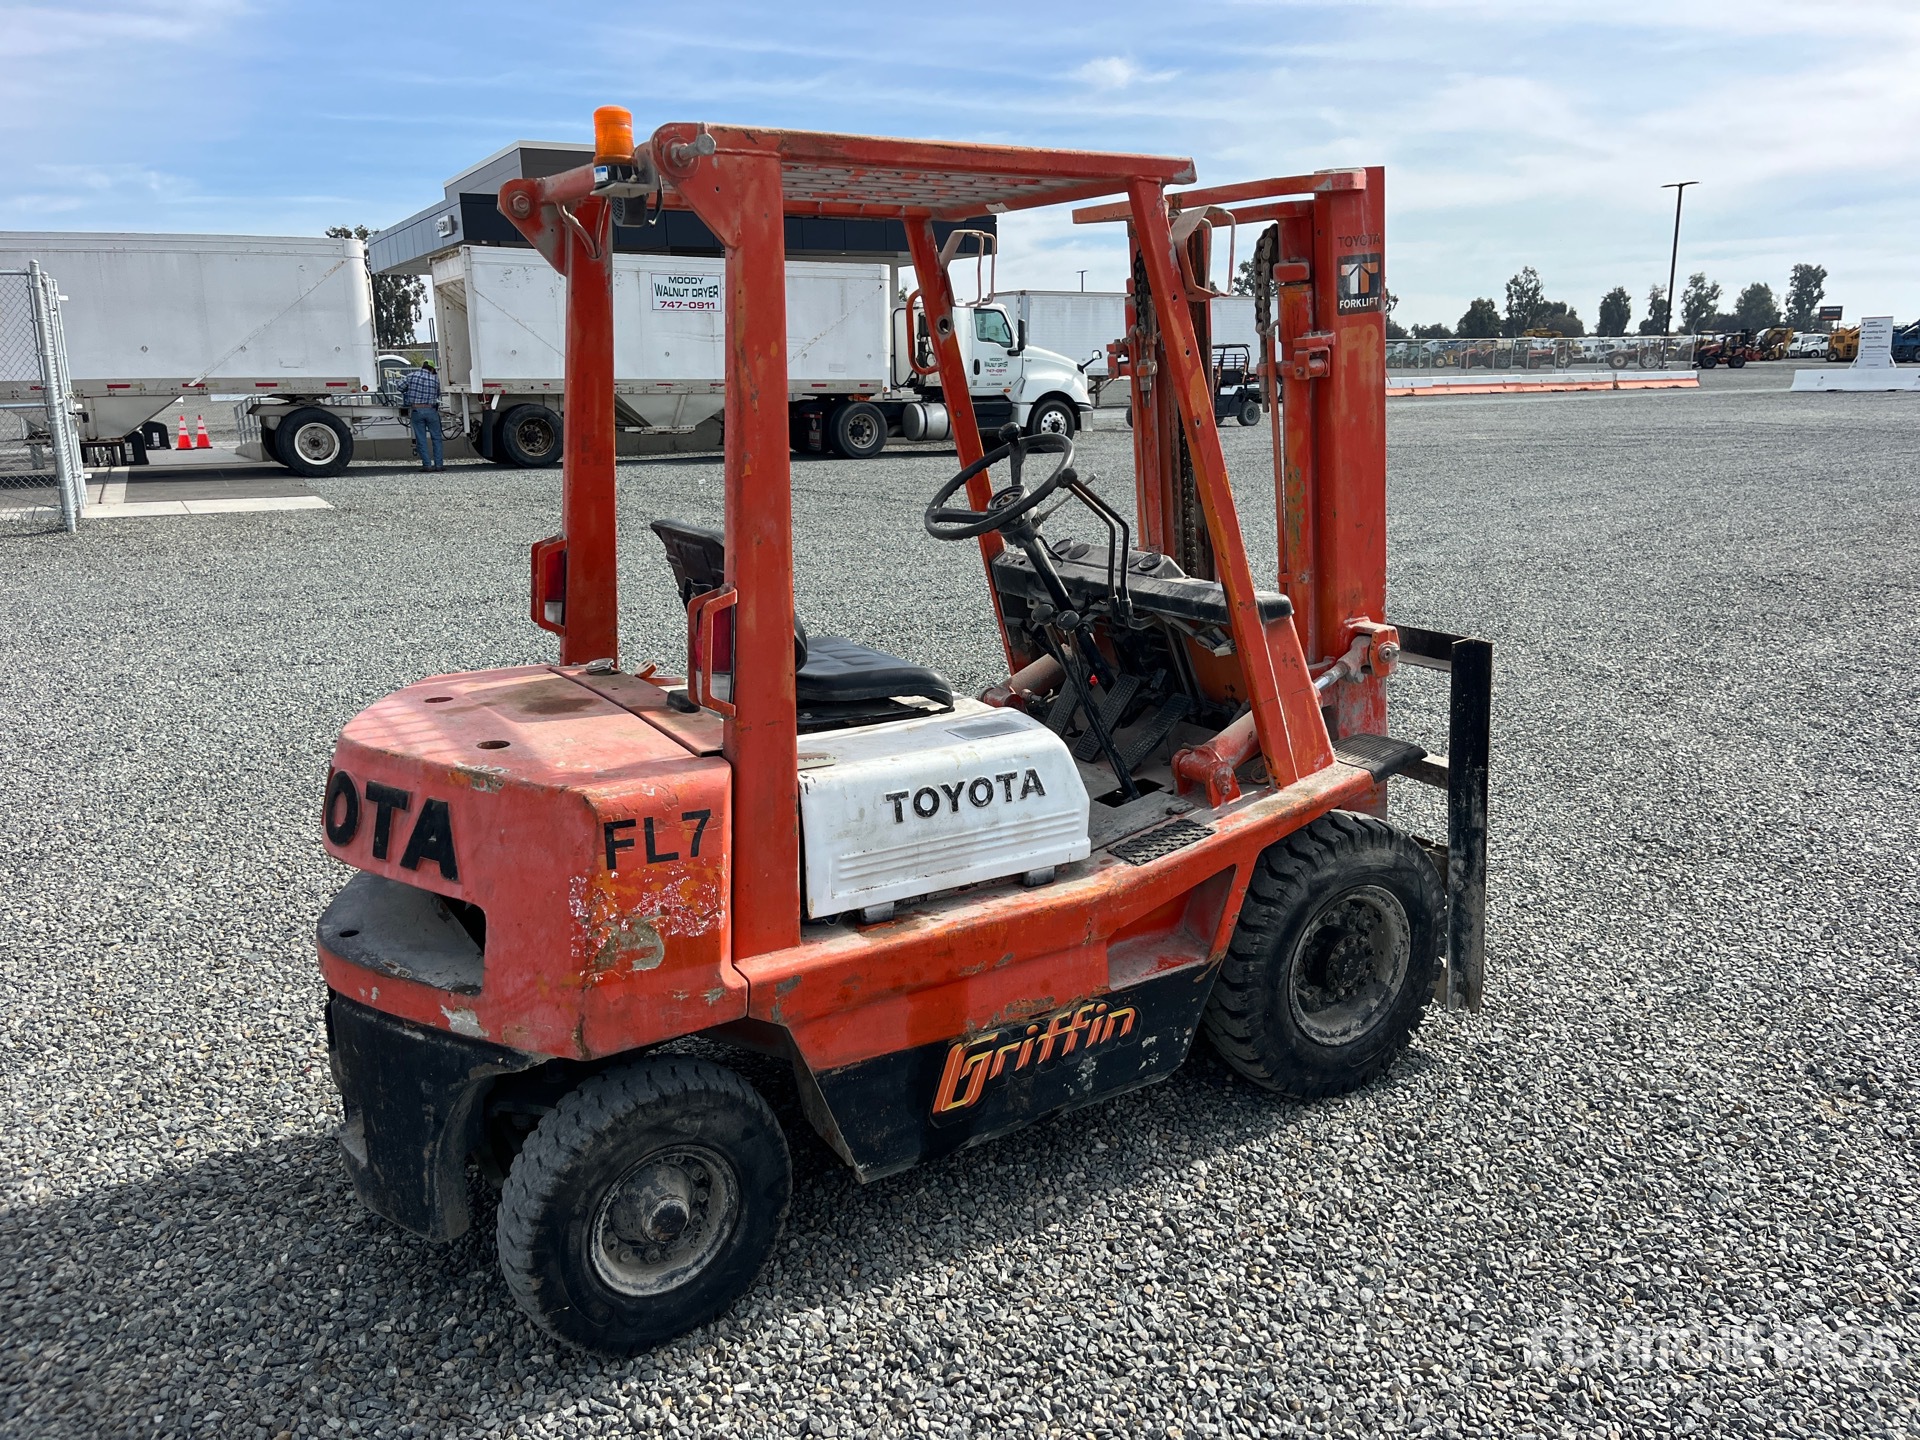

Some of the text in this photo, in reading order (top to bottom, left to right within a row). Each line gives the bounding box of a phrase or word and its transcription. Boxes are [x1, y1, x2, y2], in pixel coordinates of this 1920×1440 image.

[1338, 233, 1381, 248] TOYOTA
[668, 276, 704, 285] MOODY
[654, 282, 719, 298] WALNUT DRYER
[659, 300, 715, 309] 747-0911
[1339, 296, 1379, 309] FORKLIFT
[884, 767, 1047, 824] TOYOTA
[603, 808, 712, 871] FL7
[932, 1002, 1137, 1114] Griffin
